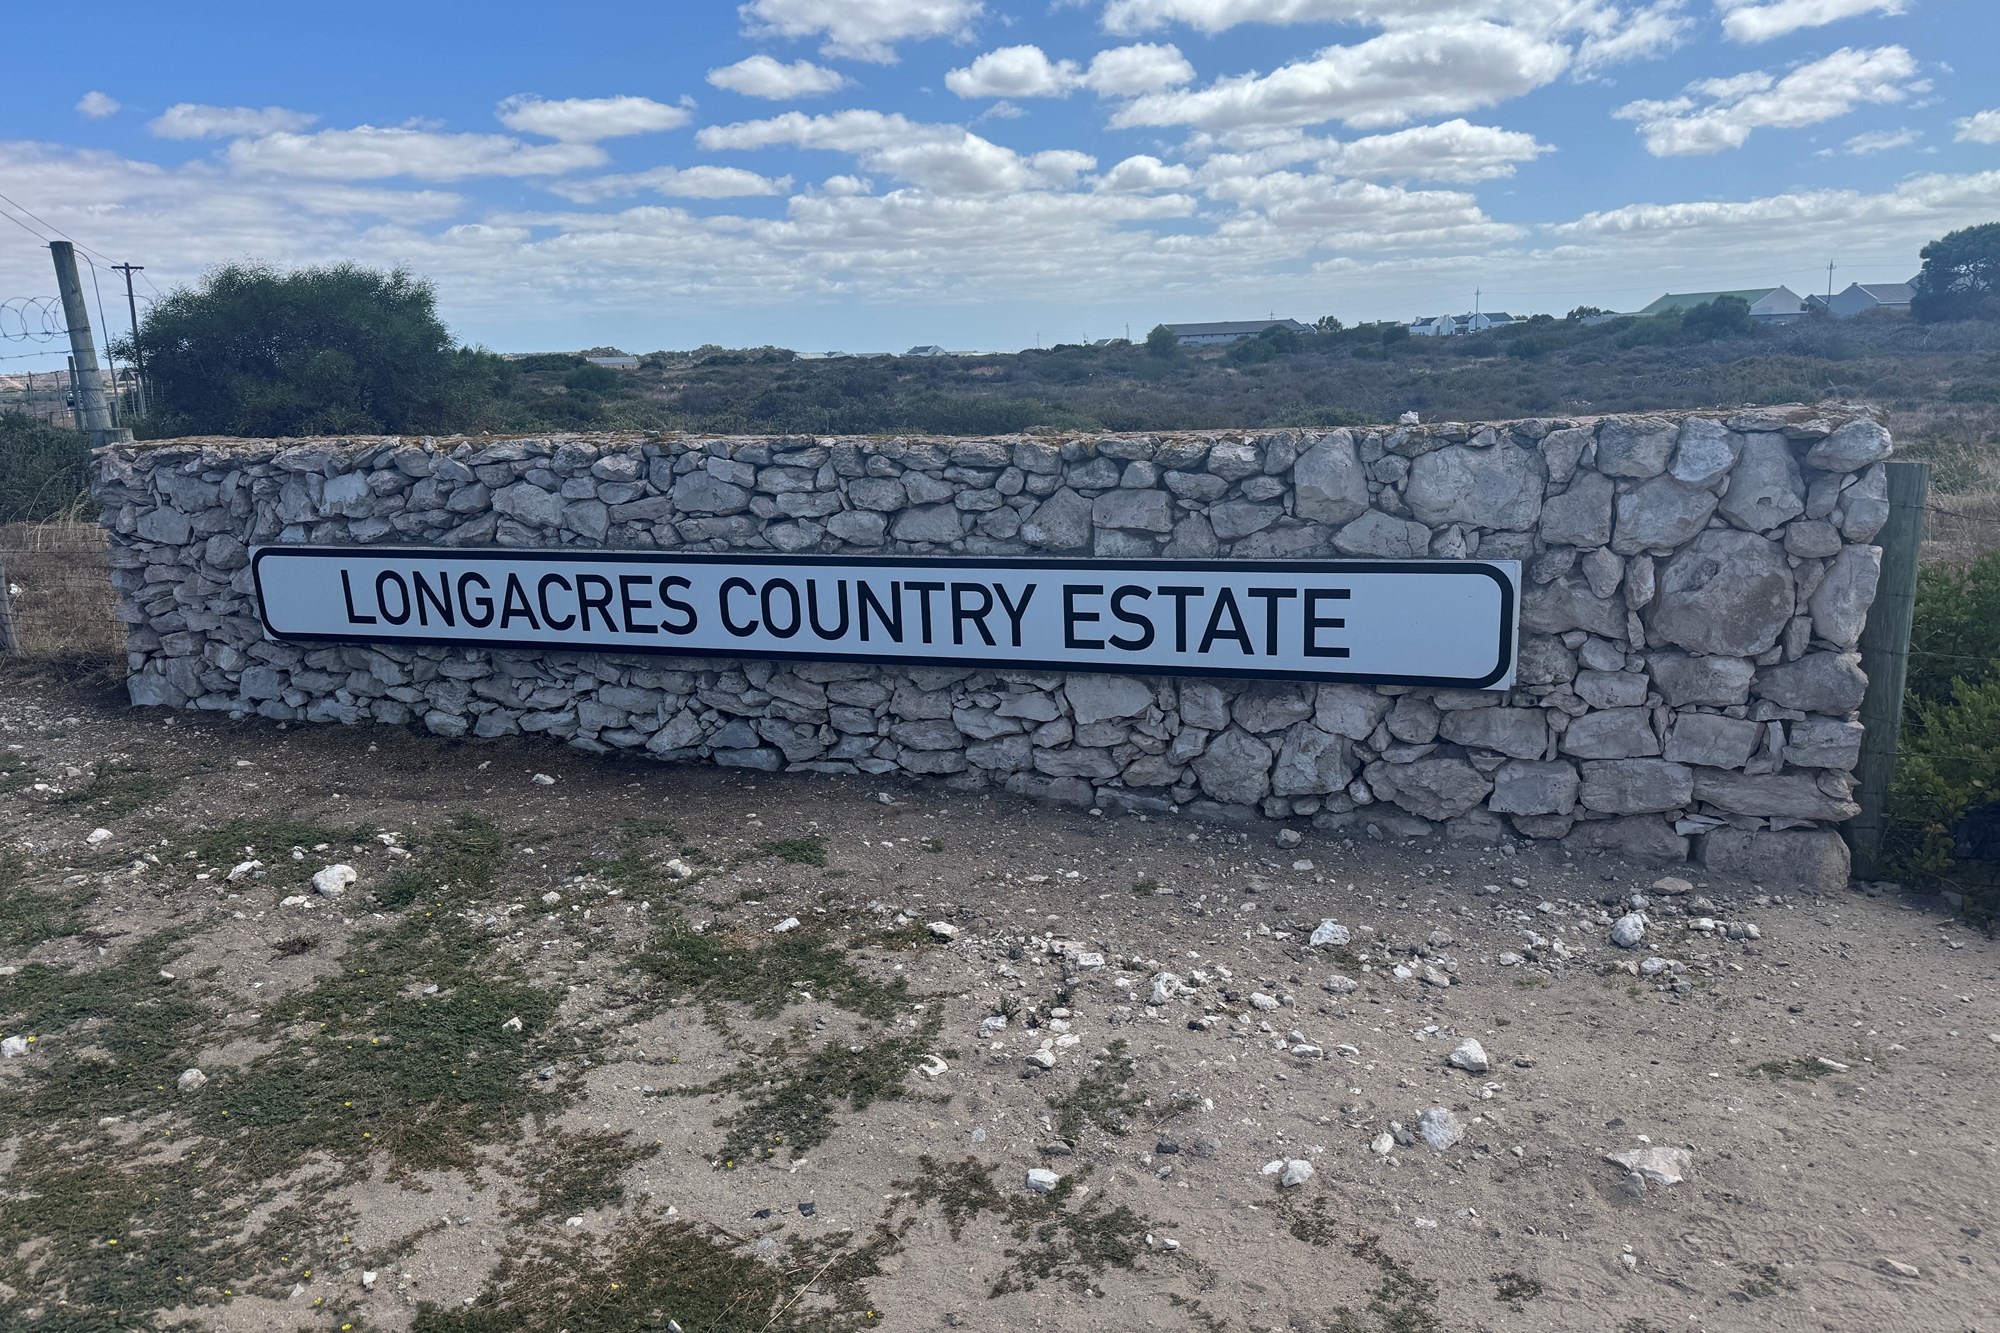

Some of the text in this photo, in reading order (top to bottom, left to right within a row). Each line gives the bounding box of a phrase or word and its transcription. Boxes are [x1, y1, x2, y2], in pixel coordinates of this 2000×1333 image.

[340, 569, 1351, 659] LONGACRES COUNTRY ESTATE
